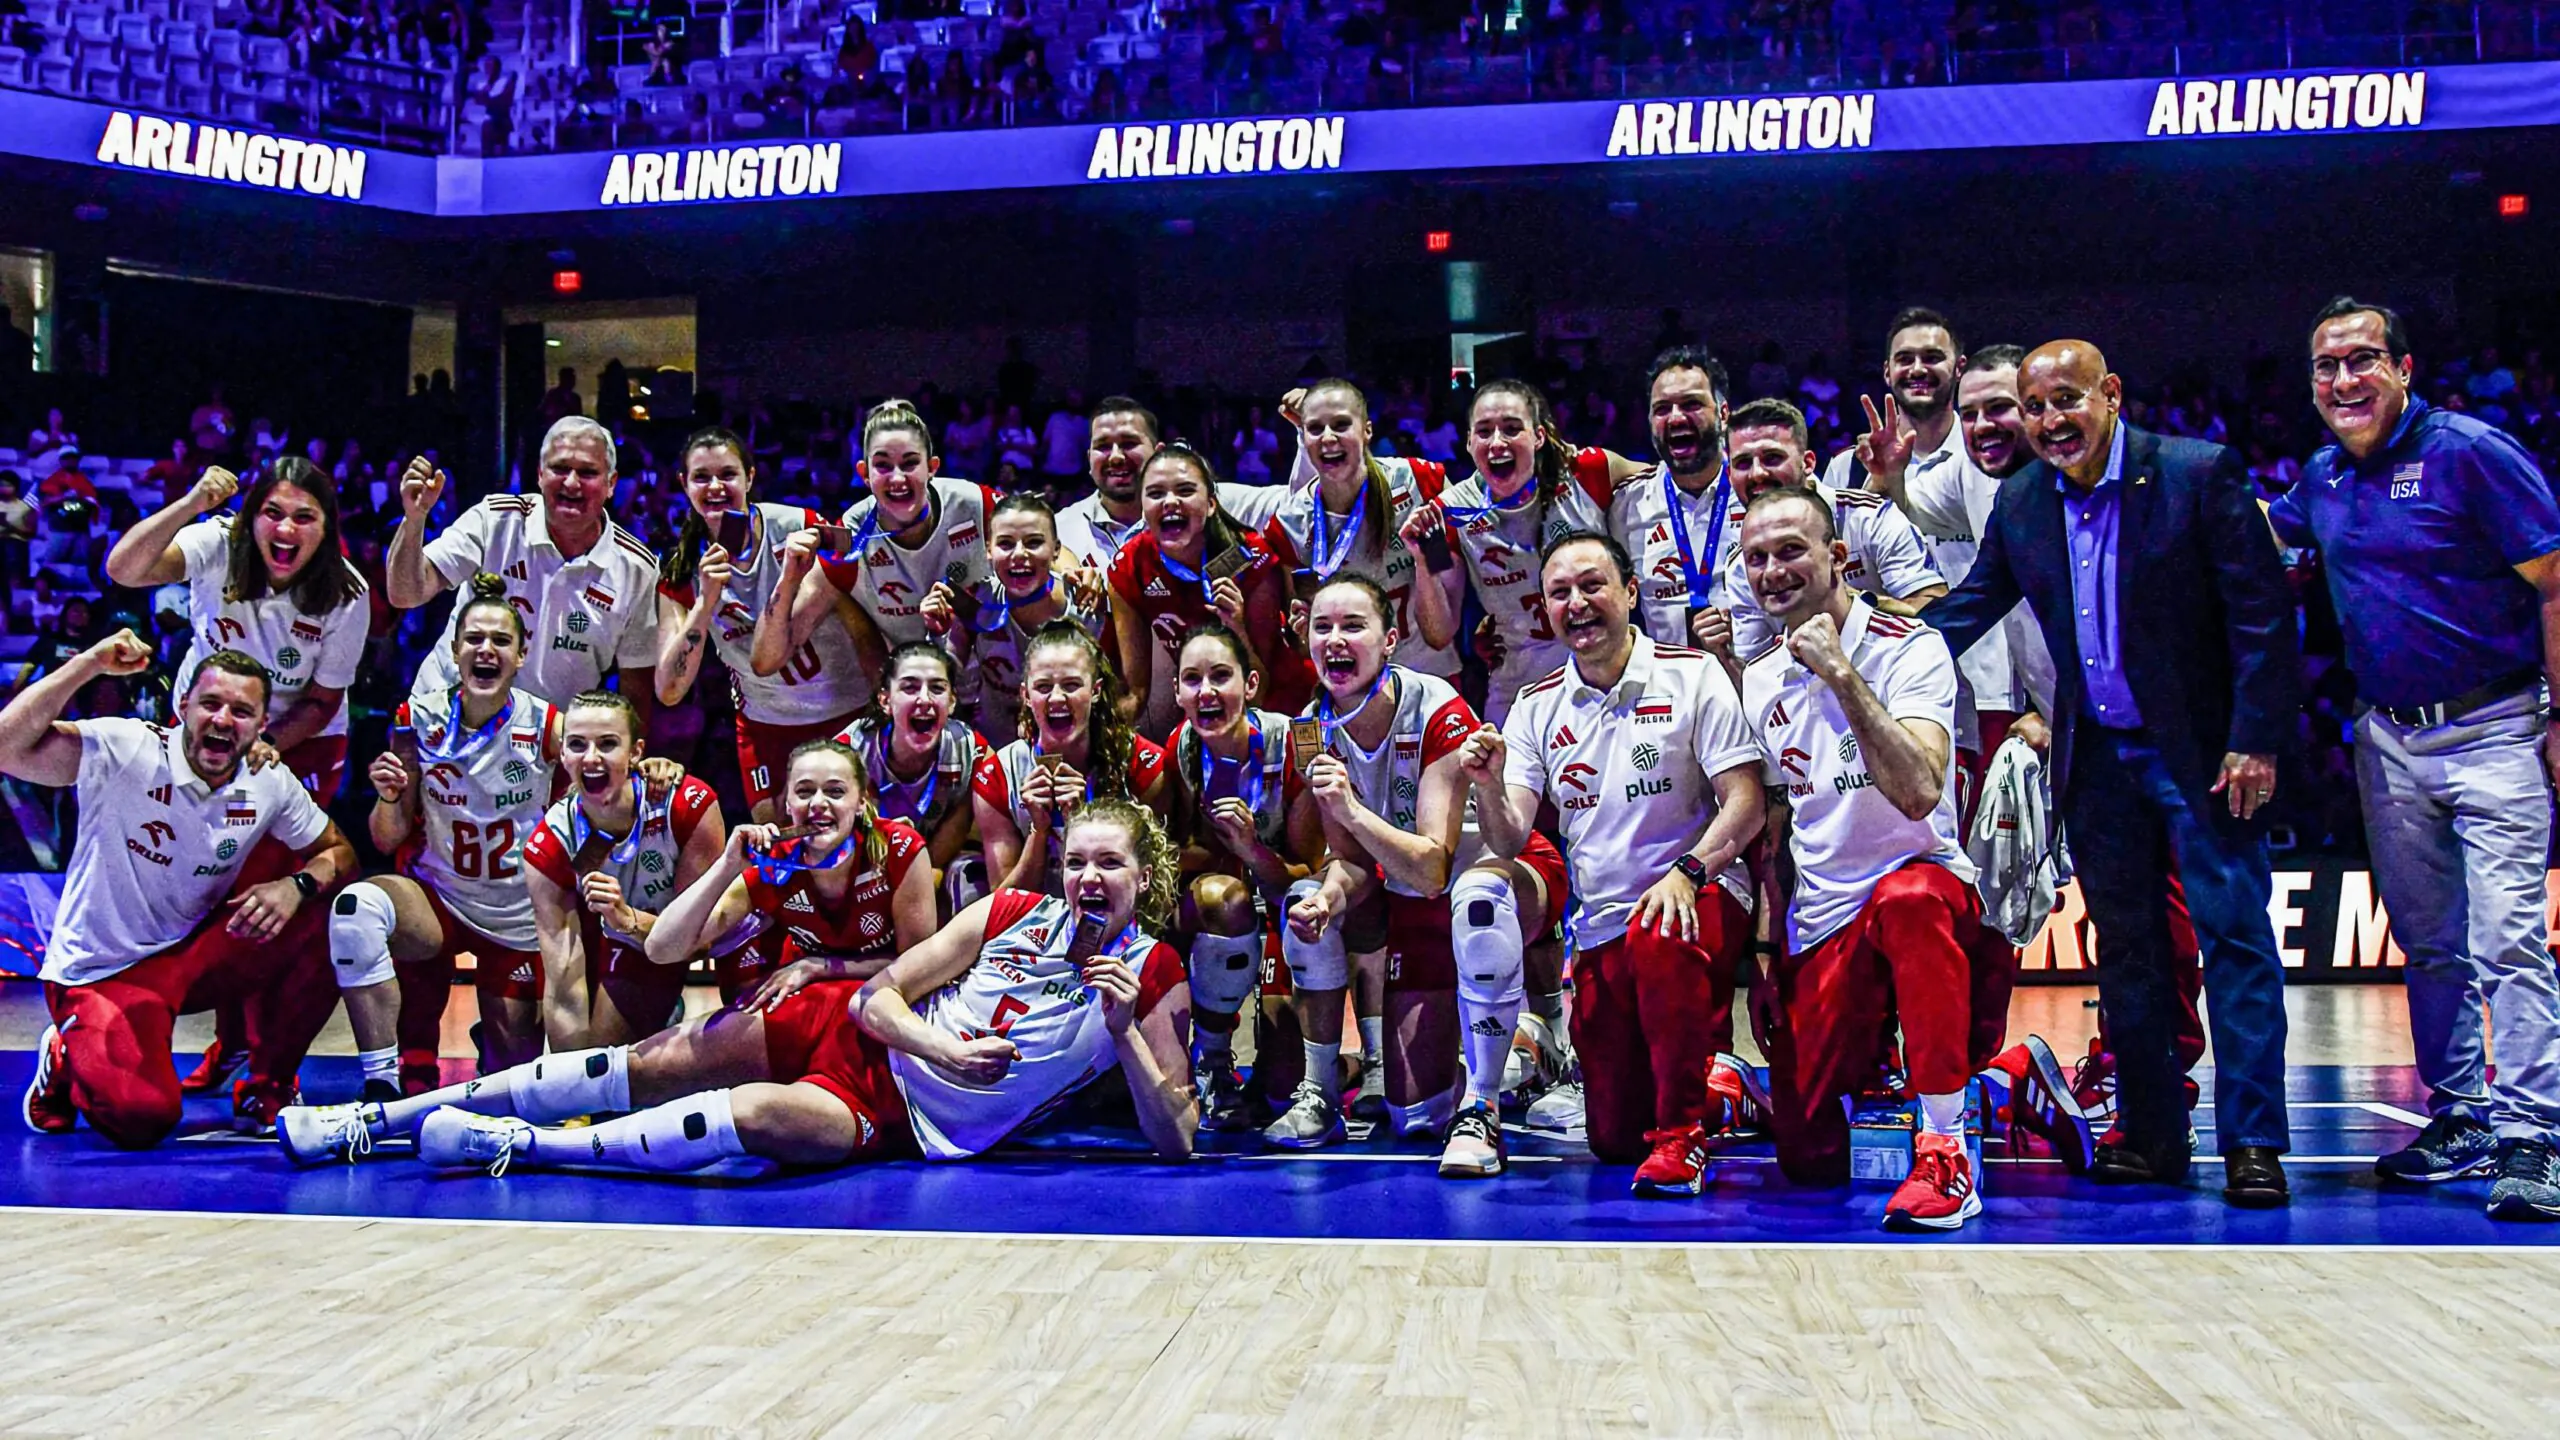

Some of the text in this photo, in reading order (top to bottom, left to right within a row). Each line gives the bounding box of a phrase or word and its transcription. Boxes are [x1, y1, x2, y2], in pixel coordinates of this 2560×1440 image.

[2148, 73, 2425, 136] ARLINGTON
[1607, 94, 1874, 157] ARLINGTON
[98, 111, 365, 199] ARLINGTON
[1088, 117, 1345, 179] ARLINGTON
[602, 142, 842, 205] ARLINGTON
[1428, 232, 1448, 249] EXIT
[2390, 481, 2420, 499] USA
[1386, 556, 1415, 579] plu
[1483, 568, 1528, 587] ORLEN
[1520, 594, 1555, 640] 3
[552, 634, 590, 654] plus
[1635, 715, 1673, 726] POLSKA
[751, 765, 770, 792] 10
[1625, 775, 1674, 803] plus
[1834, 770, 1875, 796] plus
[428, 787, 468, 806] ORLEN
[495, 789, 533, 810] plus
[1394, 806, 1418, 827] pl
[127, 836, 174, 867] ORLEN
[453, 819, 519, 881] 62
[644, 875, 675, 898] plu
[857, 884, 891, 903] POLSKA
[784, 901, 815, 914] adidas
[609, 947, 624, 972] 7
[1469, 1022, 1508, 1038] adidas
